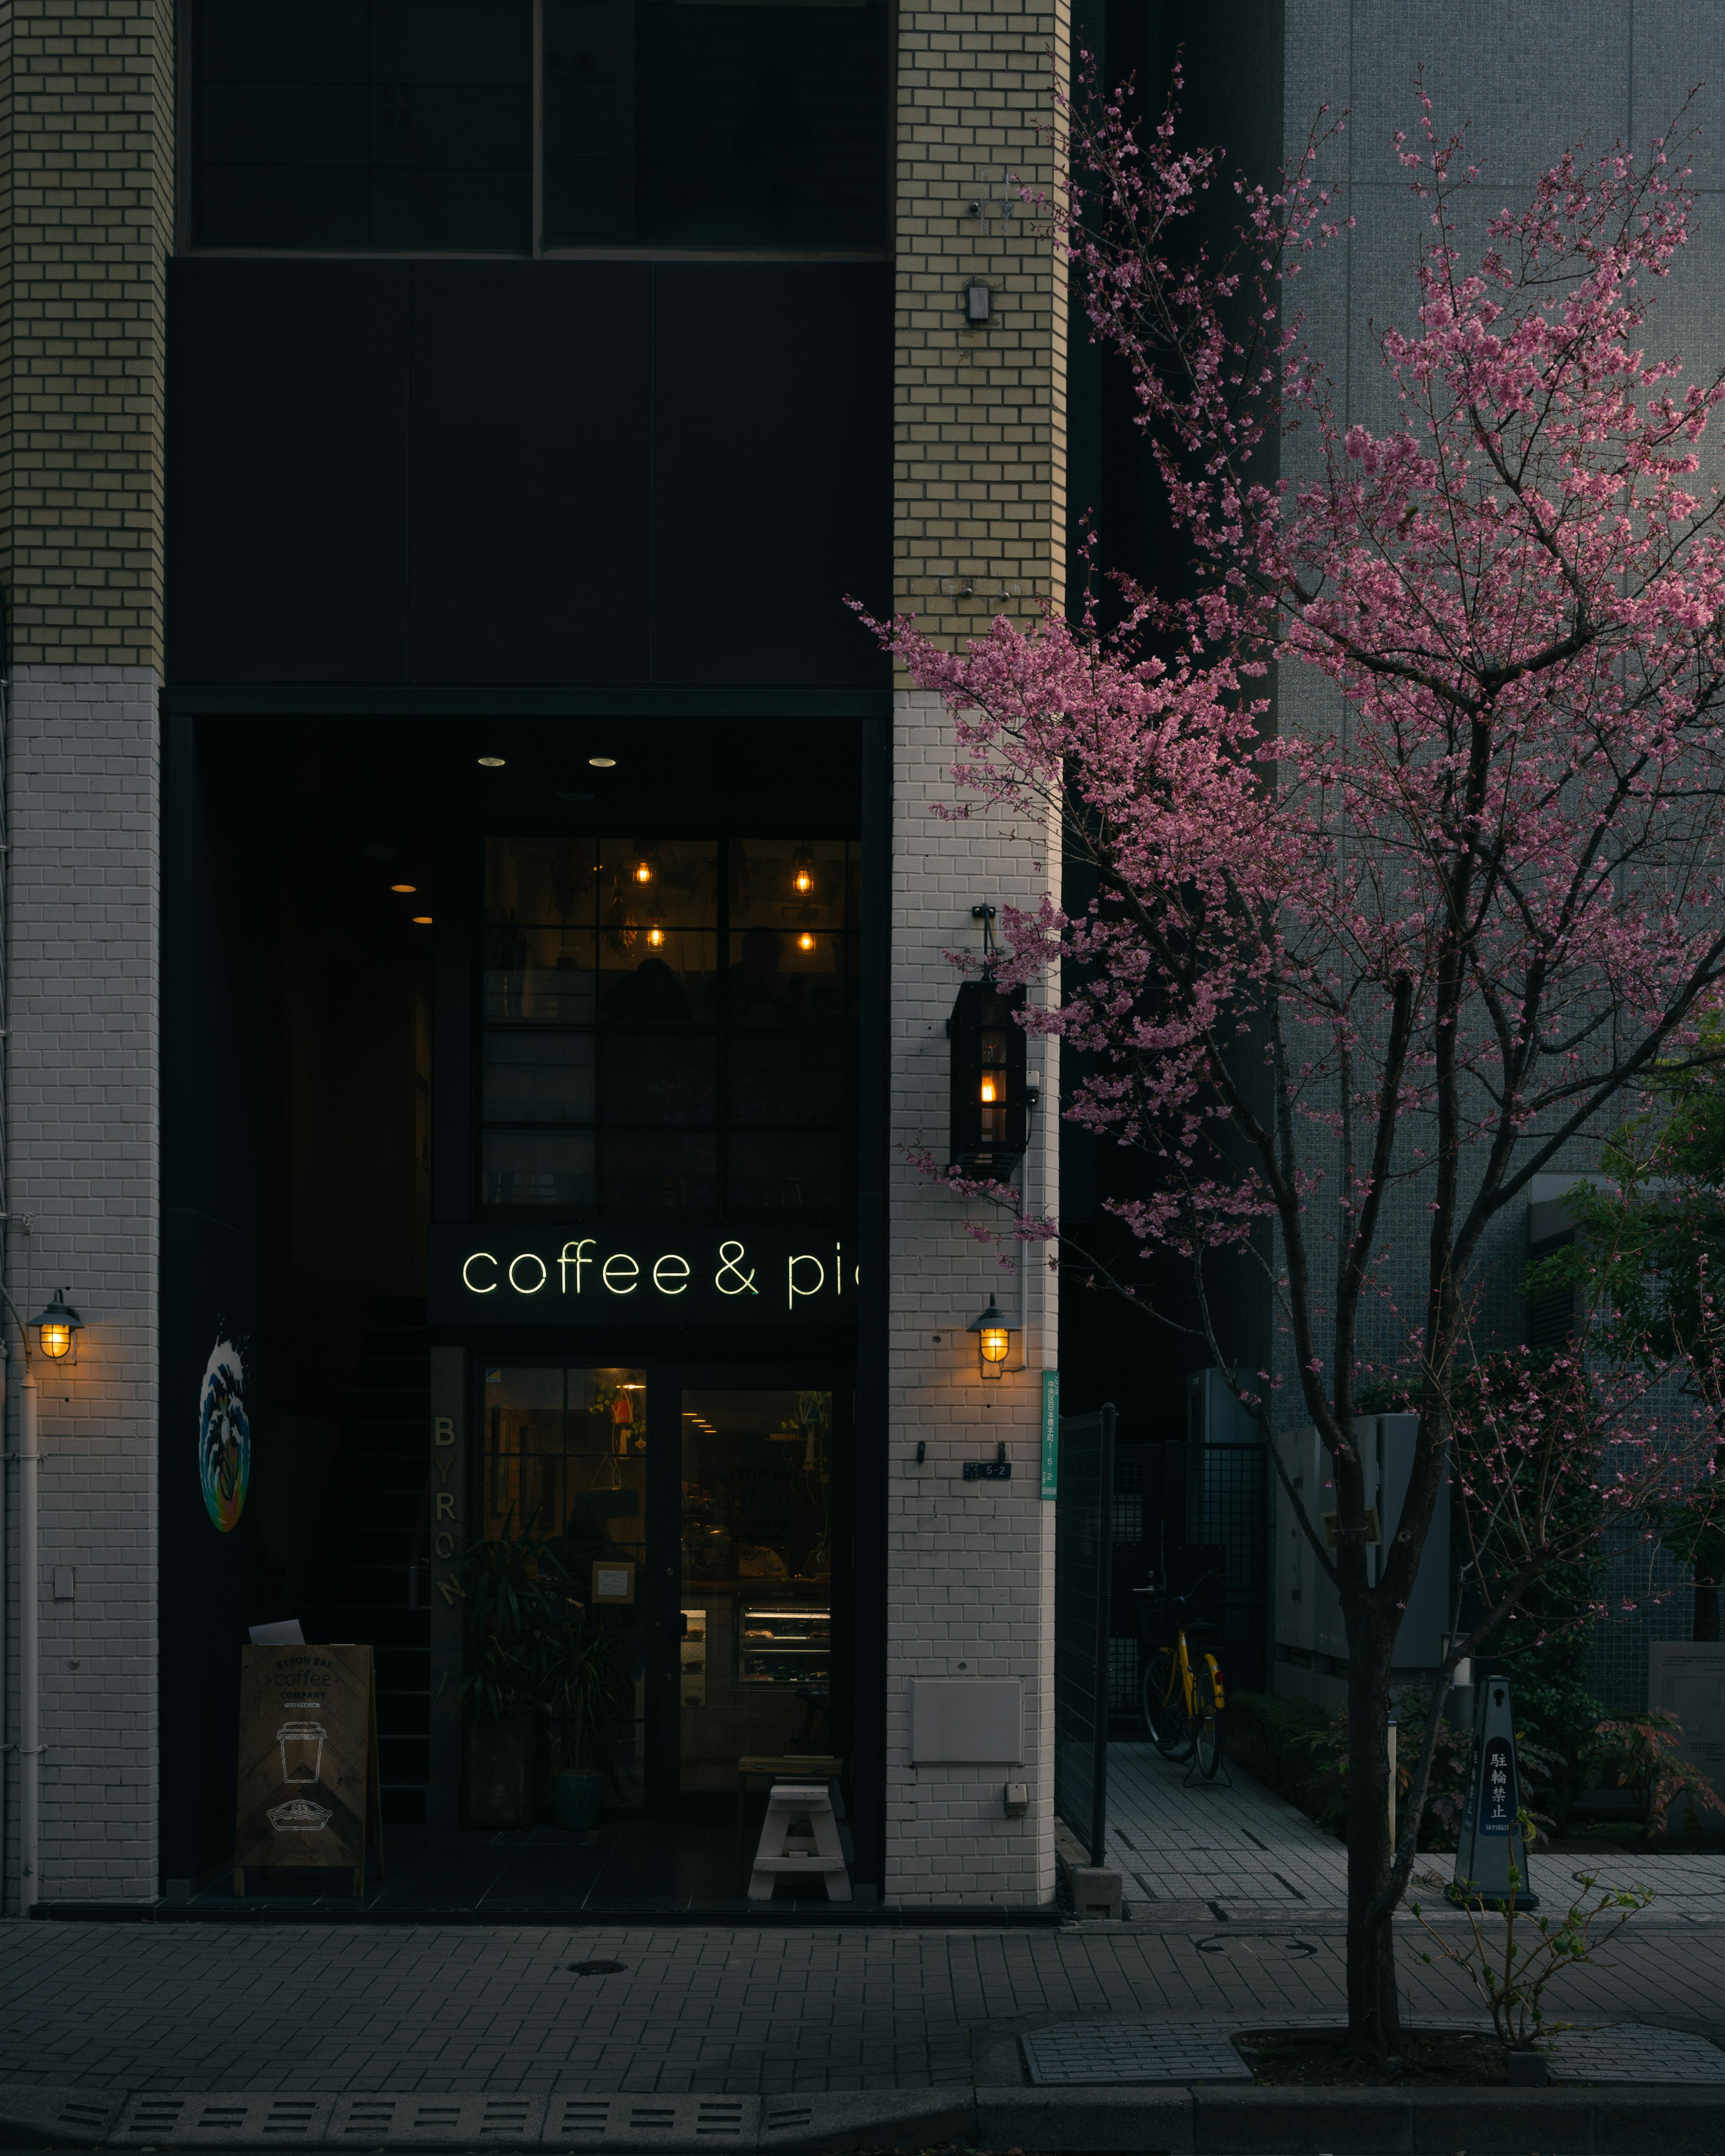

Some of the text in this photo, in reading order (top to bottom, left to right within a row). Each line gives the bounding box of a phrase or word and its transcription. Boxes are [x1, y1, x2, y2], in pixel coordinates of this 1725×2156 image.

[462, 1239, 859, 1310] coffee & pi
[986, 1466, 1005, 1474] 5-2
[717, 1487, 799, 1511] coffee
[434, 1417, 467, 1606] BYRON
[725, 1520, 791, 1529] COMPANY
[276, 1656, 333, 1668] BYRON BAY
[275, 1669, 331, 1686] coffee
[1491, 1753, 1508, 1818] 駐輪禁止
